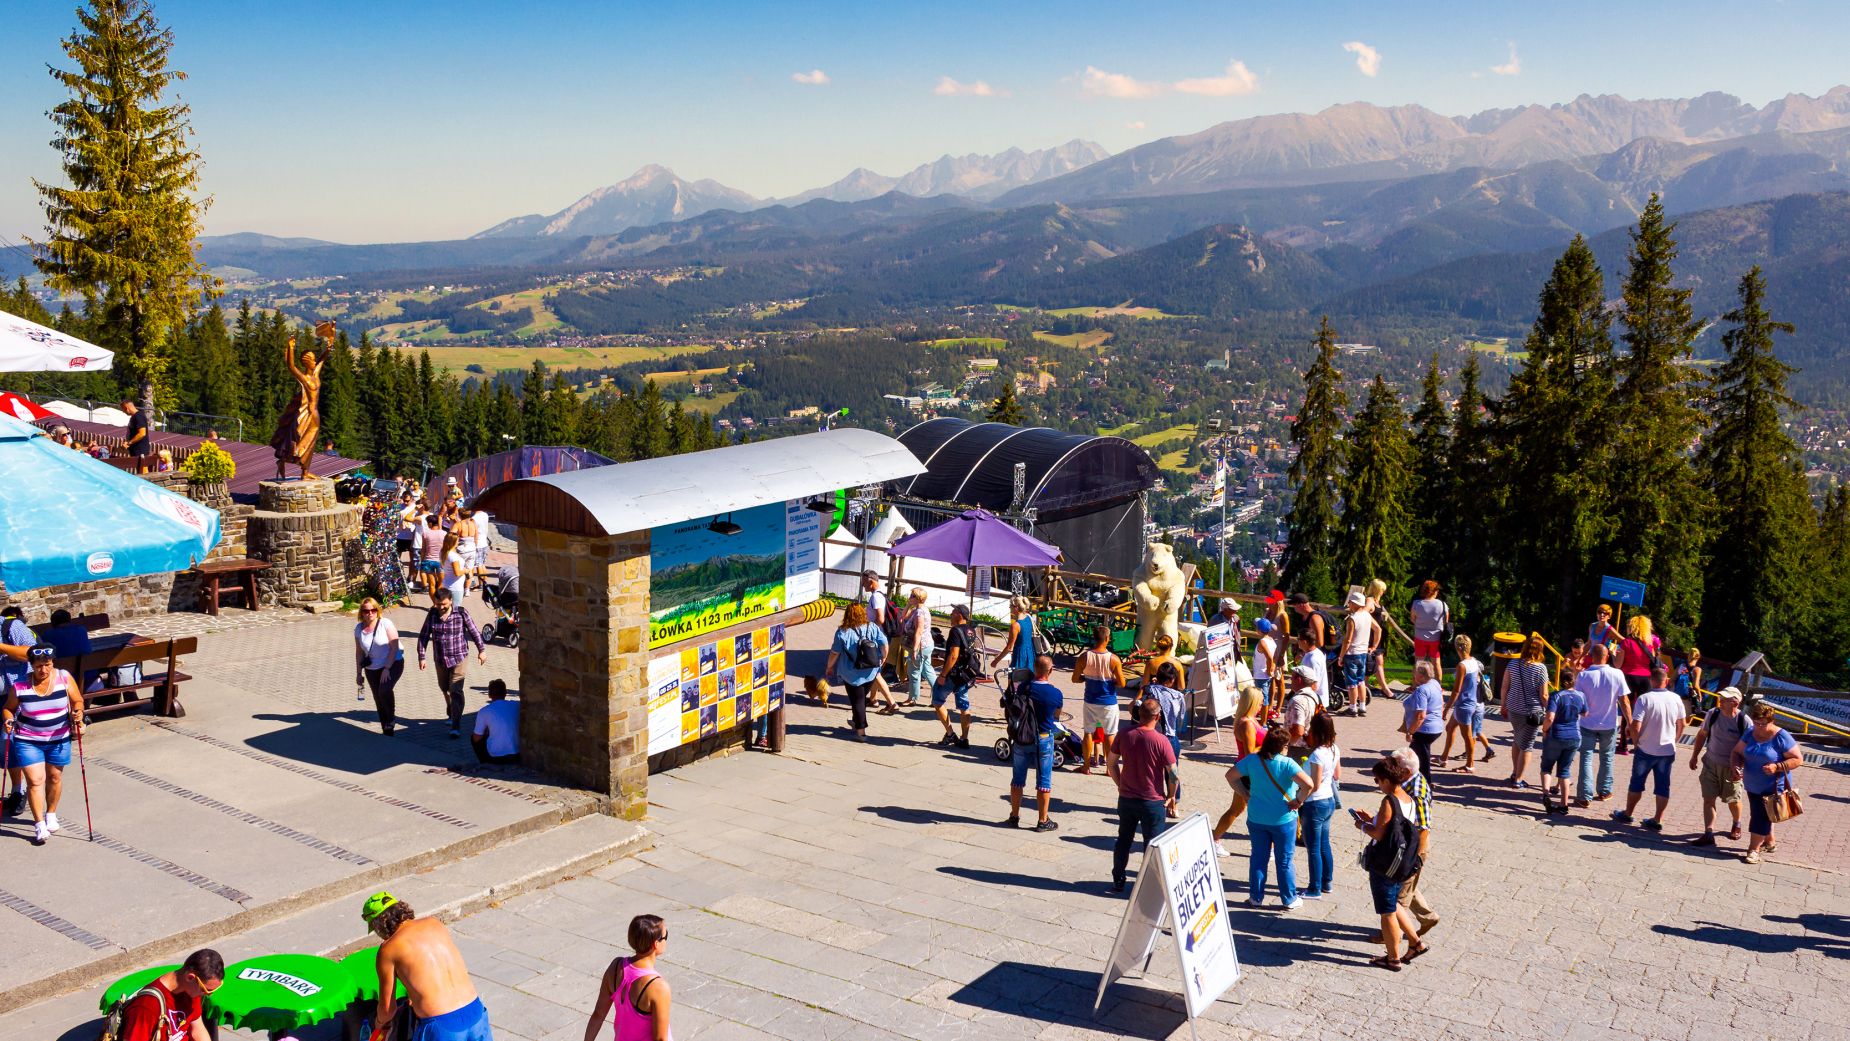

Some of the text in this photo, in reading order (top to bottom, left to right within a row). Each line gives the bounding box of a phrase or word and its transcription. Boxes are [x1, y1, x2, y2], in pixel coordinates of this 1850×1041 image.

[696, 612, 721, 630] 1123
[723, 611, 733, 622] m
[736, 602, 765, 618] n.p.m.
[1173, 849, 1209, 902] TU KUPISZ
[1177, 866, 1212, 930] BILETY
[246, 969, 316, 995] TYMBARK
